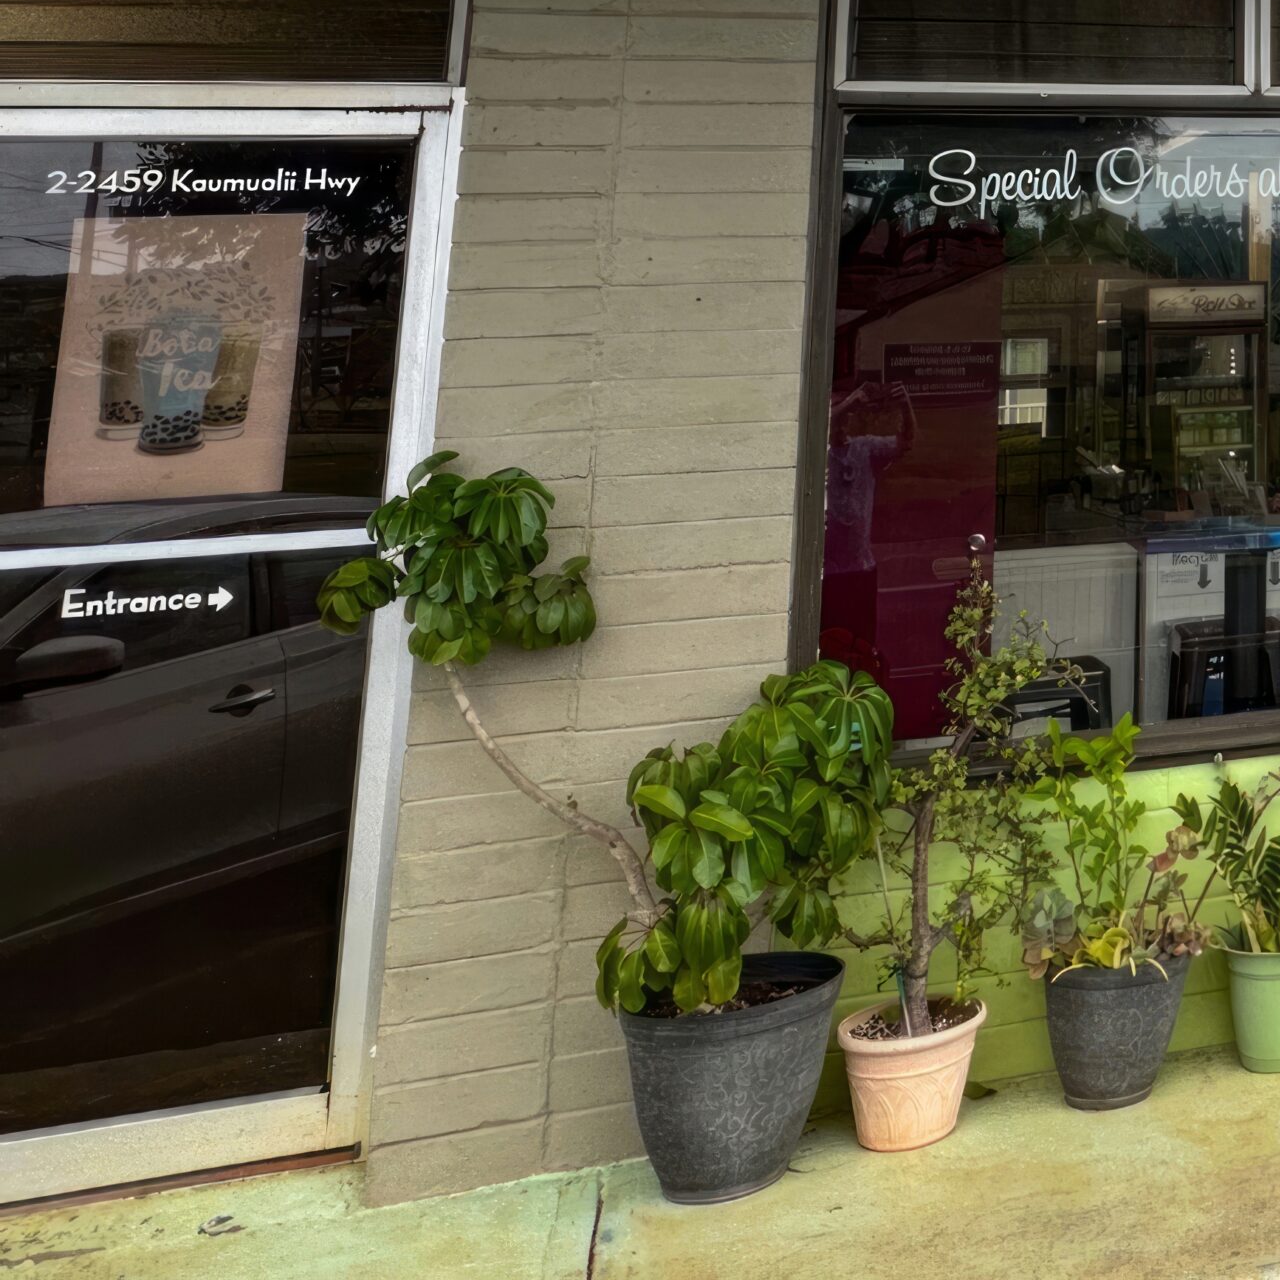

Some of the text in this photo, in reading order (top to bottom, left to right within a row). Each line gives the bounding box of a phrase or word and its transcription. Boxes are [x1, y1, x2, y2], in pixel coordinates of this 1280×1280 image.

[45, 170, 163, 194] 2-2459
[304, 167, 361, 196] Hwy
[928, 148, 1081, 221] Special
[1096, 147, 1249, 205] Orders
[61, 588, 202, 619] Entrance
